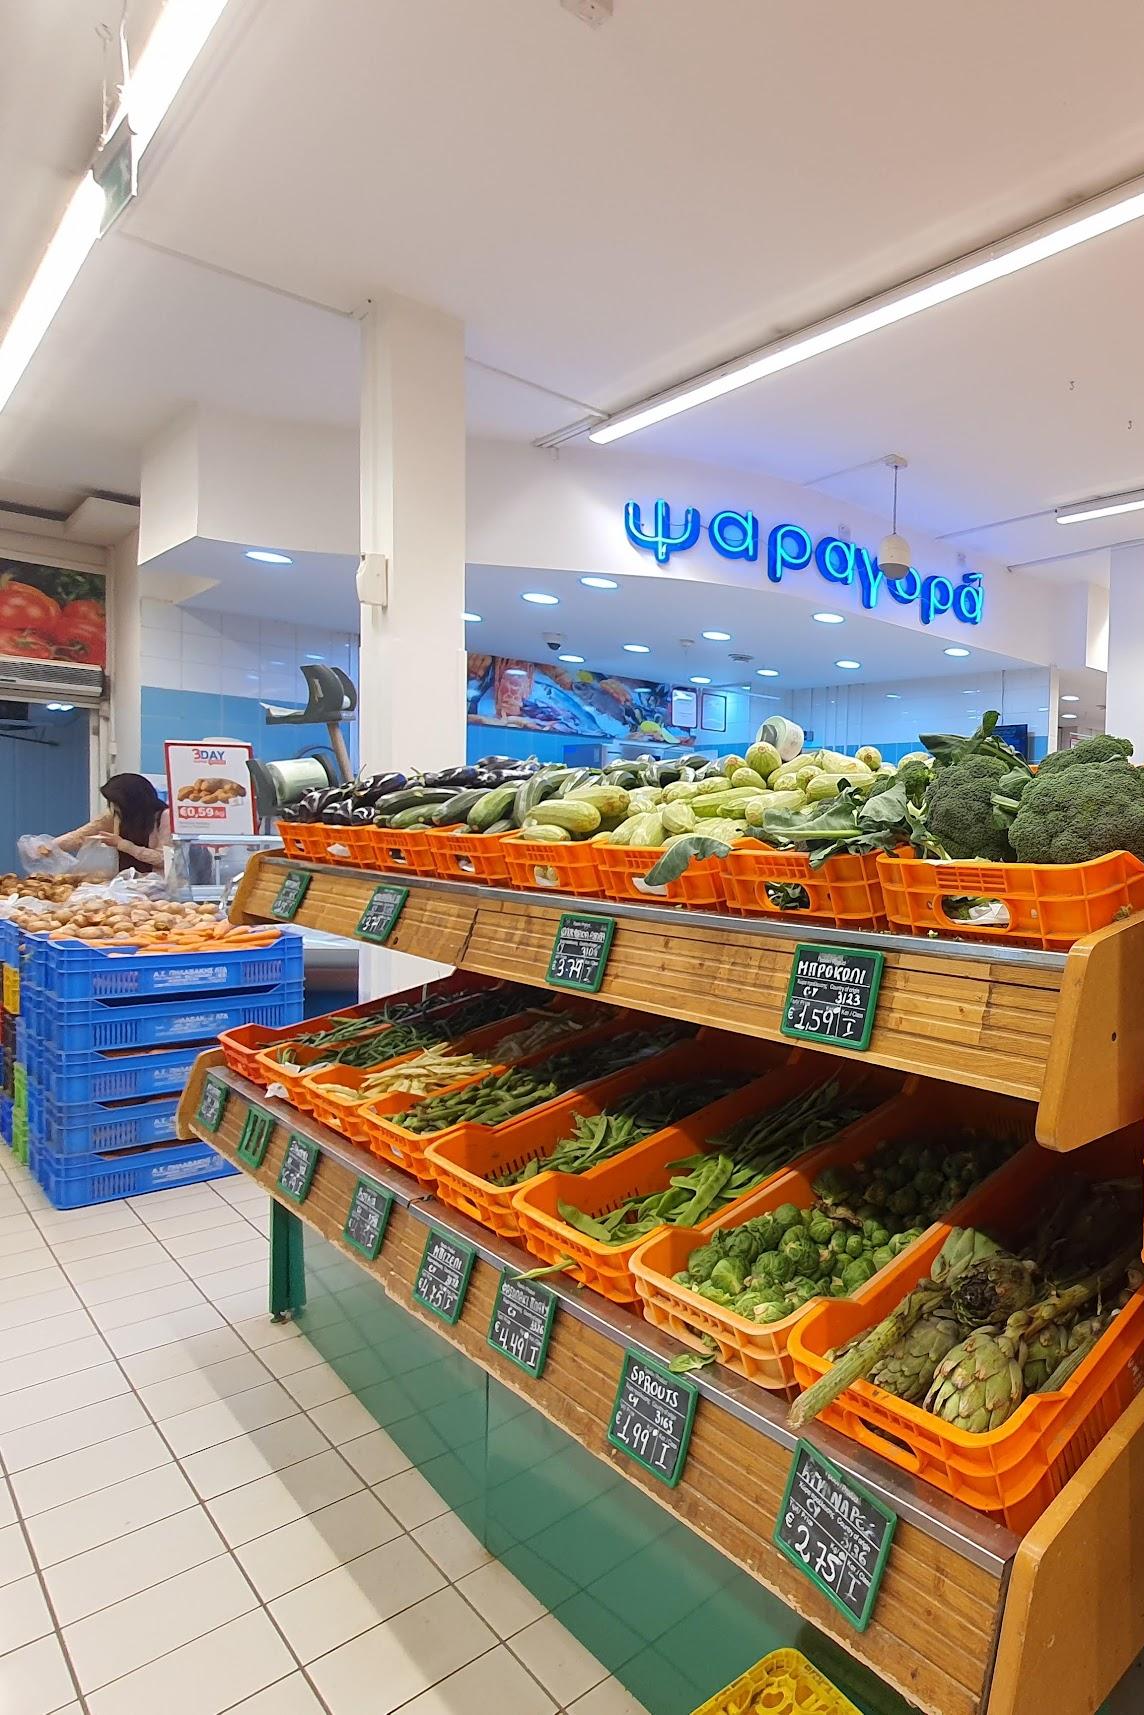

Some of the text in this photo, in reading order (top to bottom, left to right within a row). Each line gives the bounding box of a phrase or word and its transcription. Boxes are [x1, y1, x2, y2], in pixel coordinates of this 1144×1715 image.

[624, 499, 984, 625] ψαραγορά
[192, 748, 225, 760] 3DAY
[787, 1007, 795, 1020] €
[630, 1365, 679, 1408] SPROUTS
[615, 1410, 622, 1425] €
[785, 1511, 795, 1529] €
